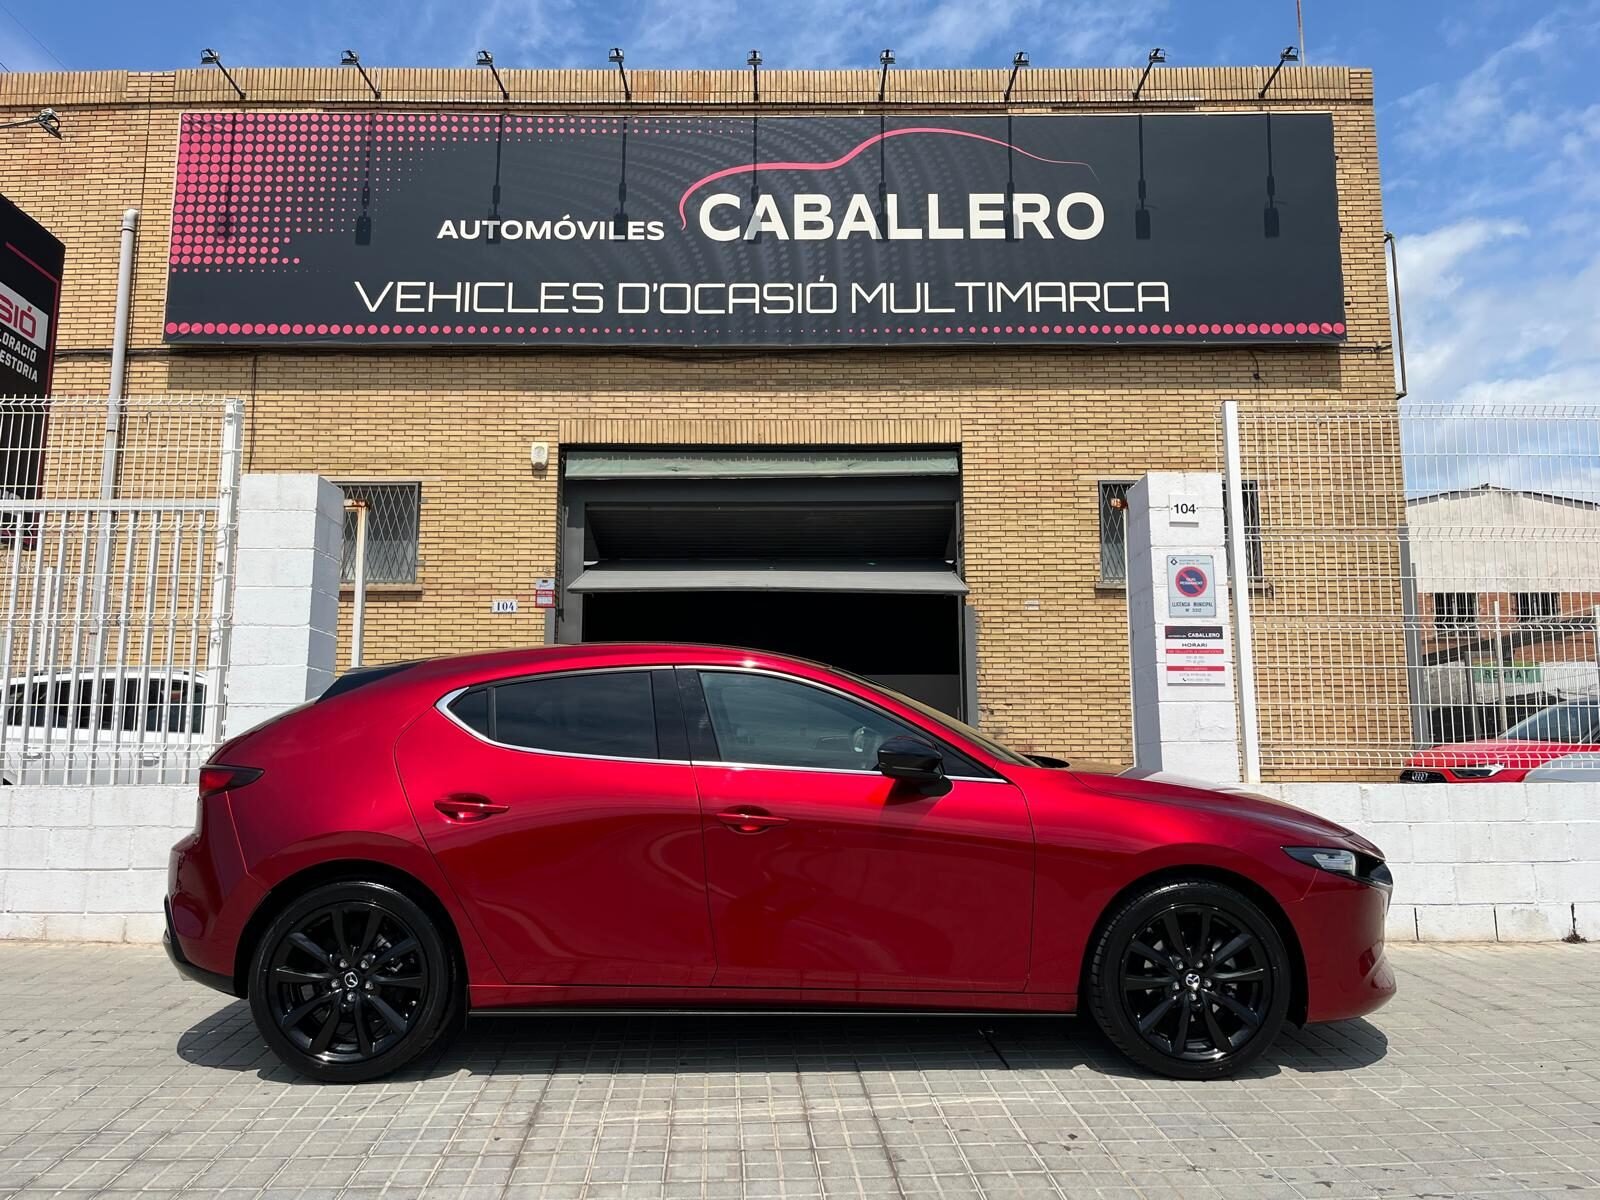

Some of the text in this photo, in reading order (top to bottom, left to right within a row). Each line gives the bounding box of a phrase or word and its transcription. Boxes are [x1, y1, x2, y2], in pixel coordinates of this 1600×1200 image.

[436, 191, 1105, 242] AUTOMÓVILES CABALLERO
[353, 274, 1170, 315] VEHICLES D'OCASIÓ MULTIMARCA
[1173, 503, 1197, 515] 104
[497, 602, 514, 611] 104
